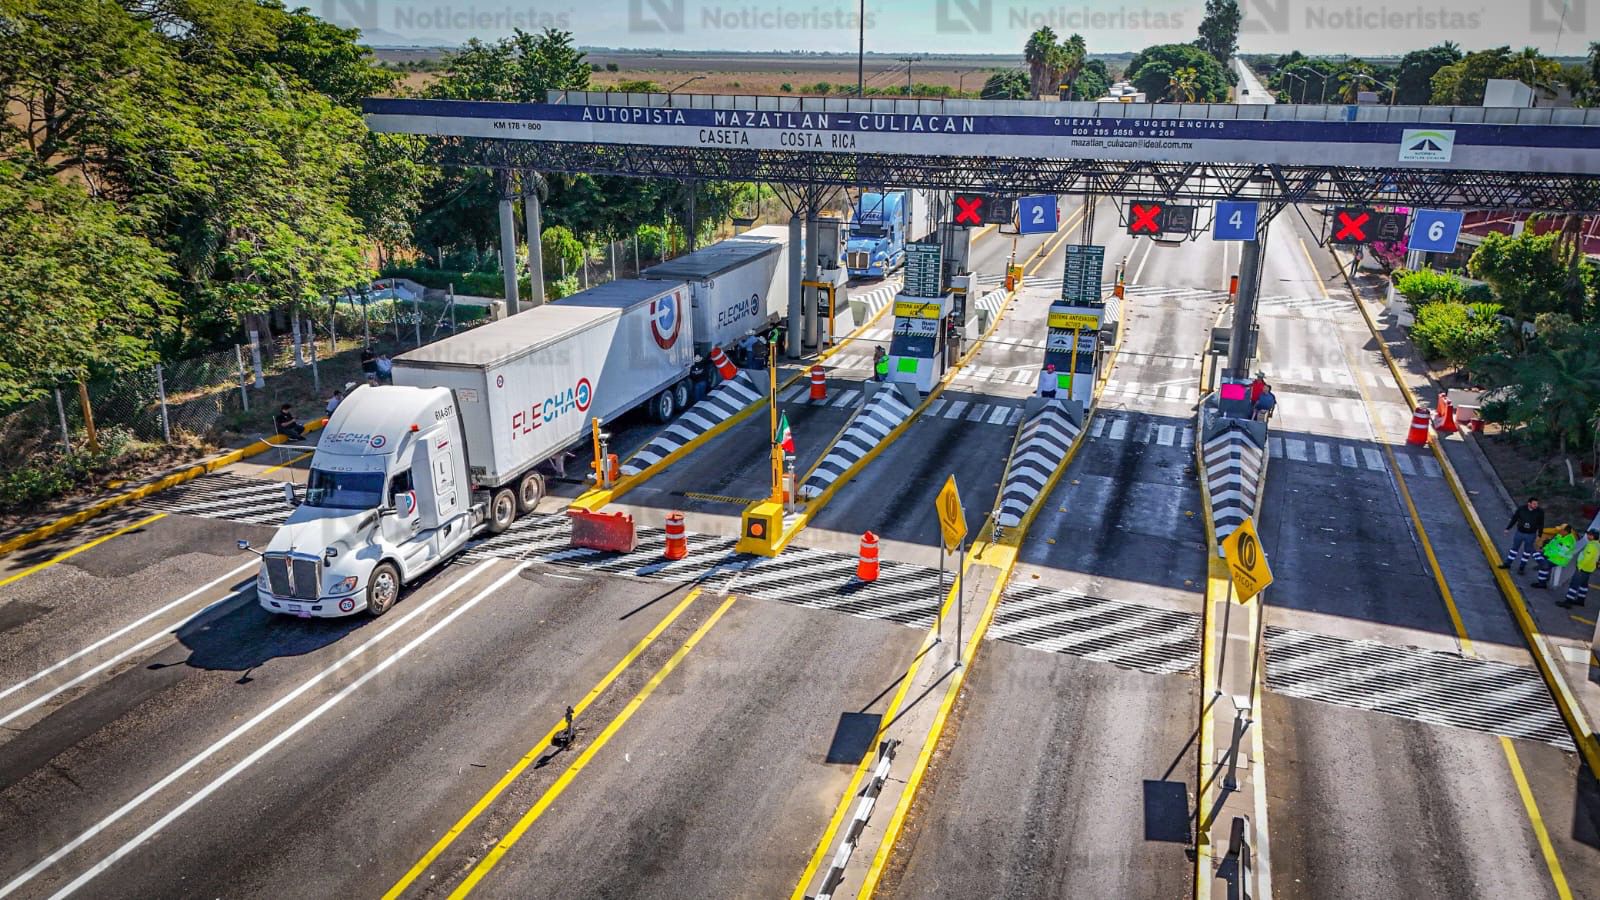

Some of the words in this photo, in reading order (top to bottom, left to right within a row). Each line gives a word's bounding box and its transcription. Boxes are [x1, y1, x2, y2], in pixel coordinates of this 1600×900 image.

[493, 121, 506, 130] KM
[508, 122, 520, 131] 178
[527, 122, 542, 131] 800
[582, 106, 686, 125] AUTOPISTA
[714, 111, 829, 129] MAZATLAN
[859, 115, 974, 132] CULIACAN
[1054, 118, 1102, 126] QUEJAS
[1115, 119, 1122, 127] Y
[1134, 120, 1225, 129] SUGERENCIAS
[699, 129, 749, 145] CASETA
[780, 131, 823, 148] COSTA
[832, 133, 856, 149] RICA
[1032, 205, 1045, 225] 2
[1228, 210, 1243, 230] 4
[1428, 220, 1445, 242] 6
[512, 387, 576, 441] FLECHA
